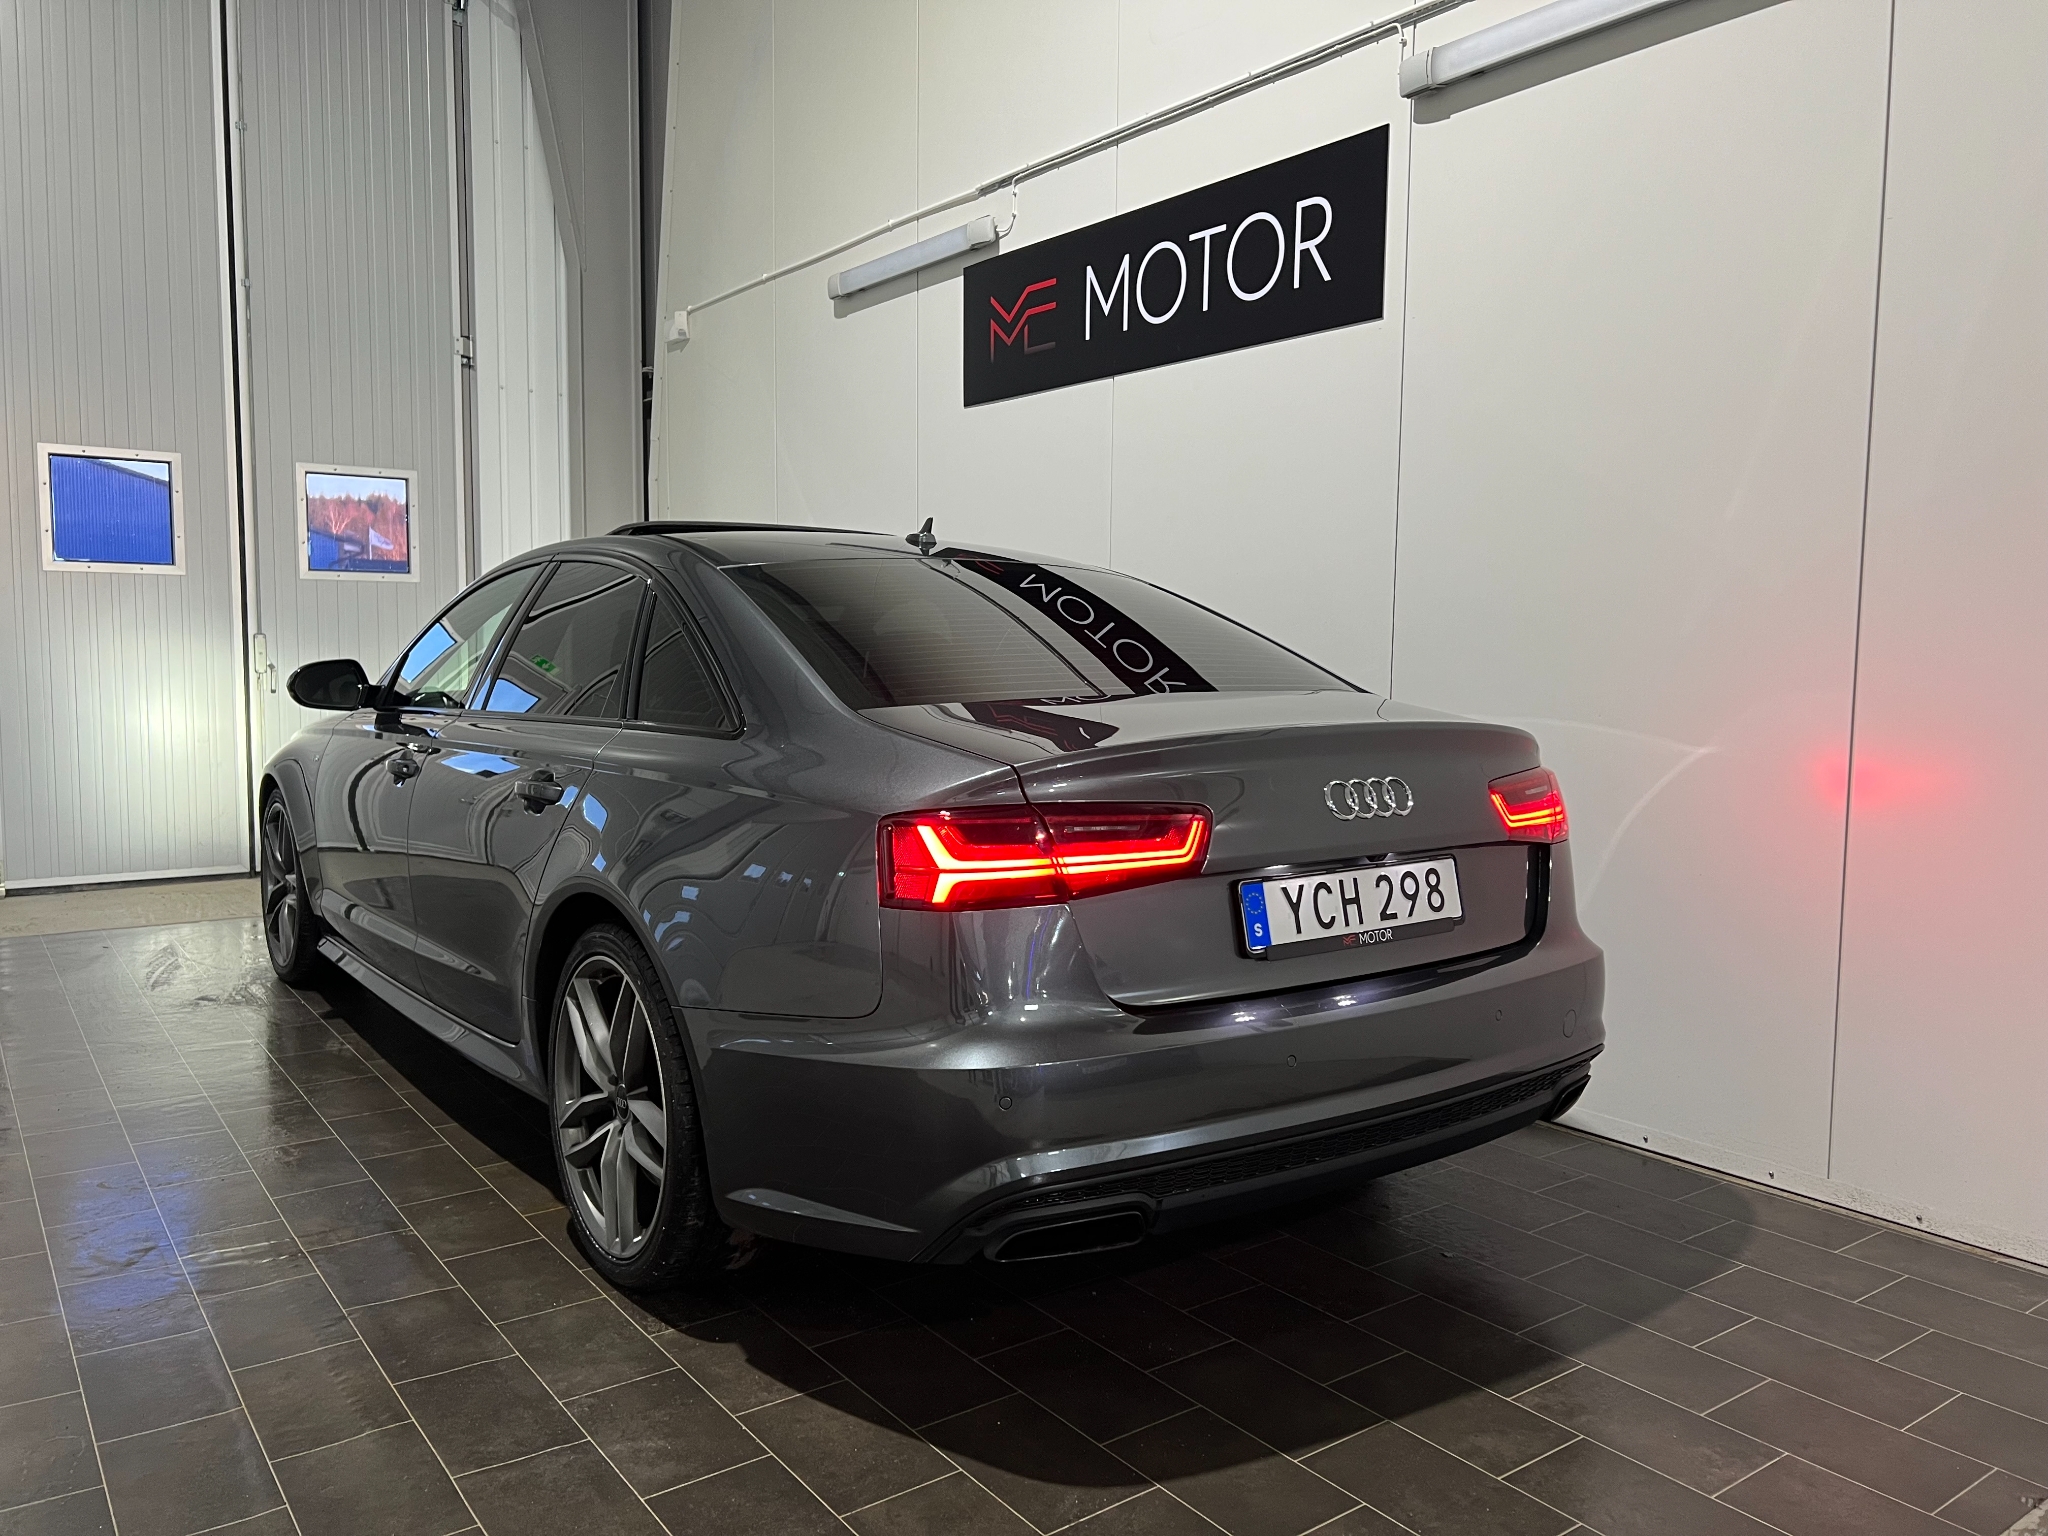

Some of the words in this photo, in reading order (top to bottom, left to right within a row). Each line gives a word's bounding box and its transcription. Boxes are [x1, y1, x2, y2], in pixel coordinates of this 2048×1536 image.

[1085, 196, 1333, 341] MOTOR
[1281, 877, 1364, 935] YCH
[1375, 867, 1445, 922] 298
[1254, 923, 1263, 937] S
[1359, 928, 1393, 945] MOTOR
